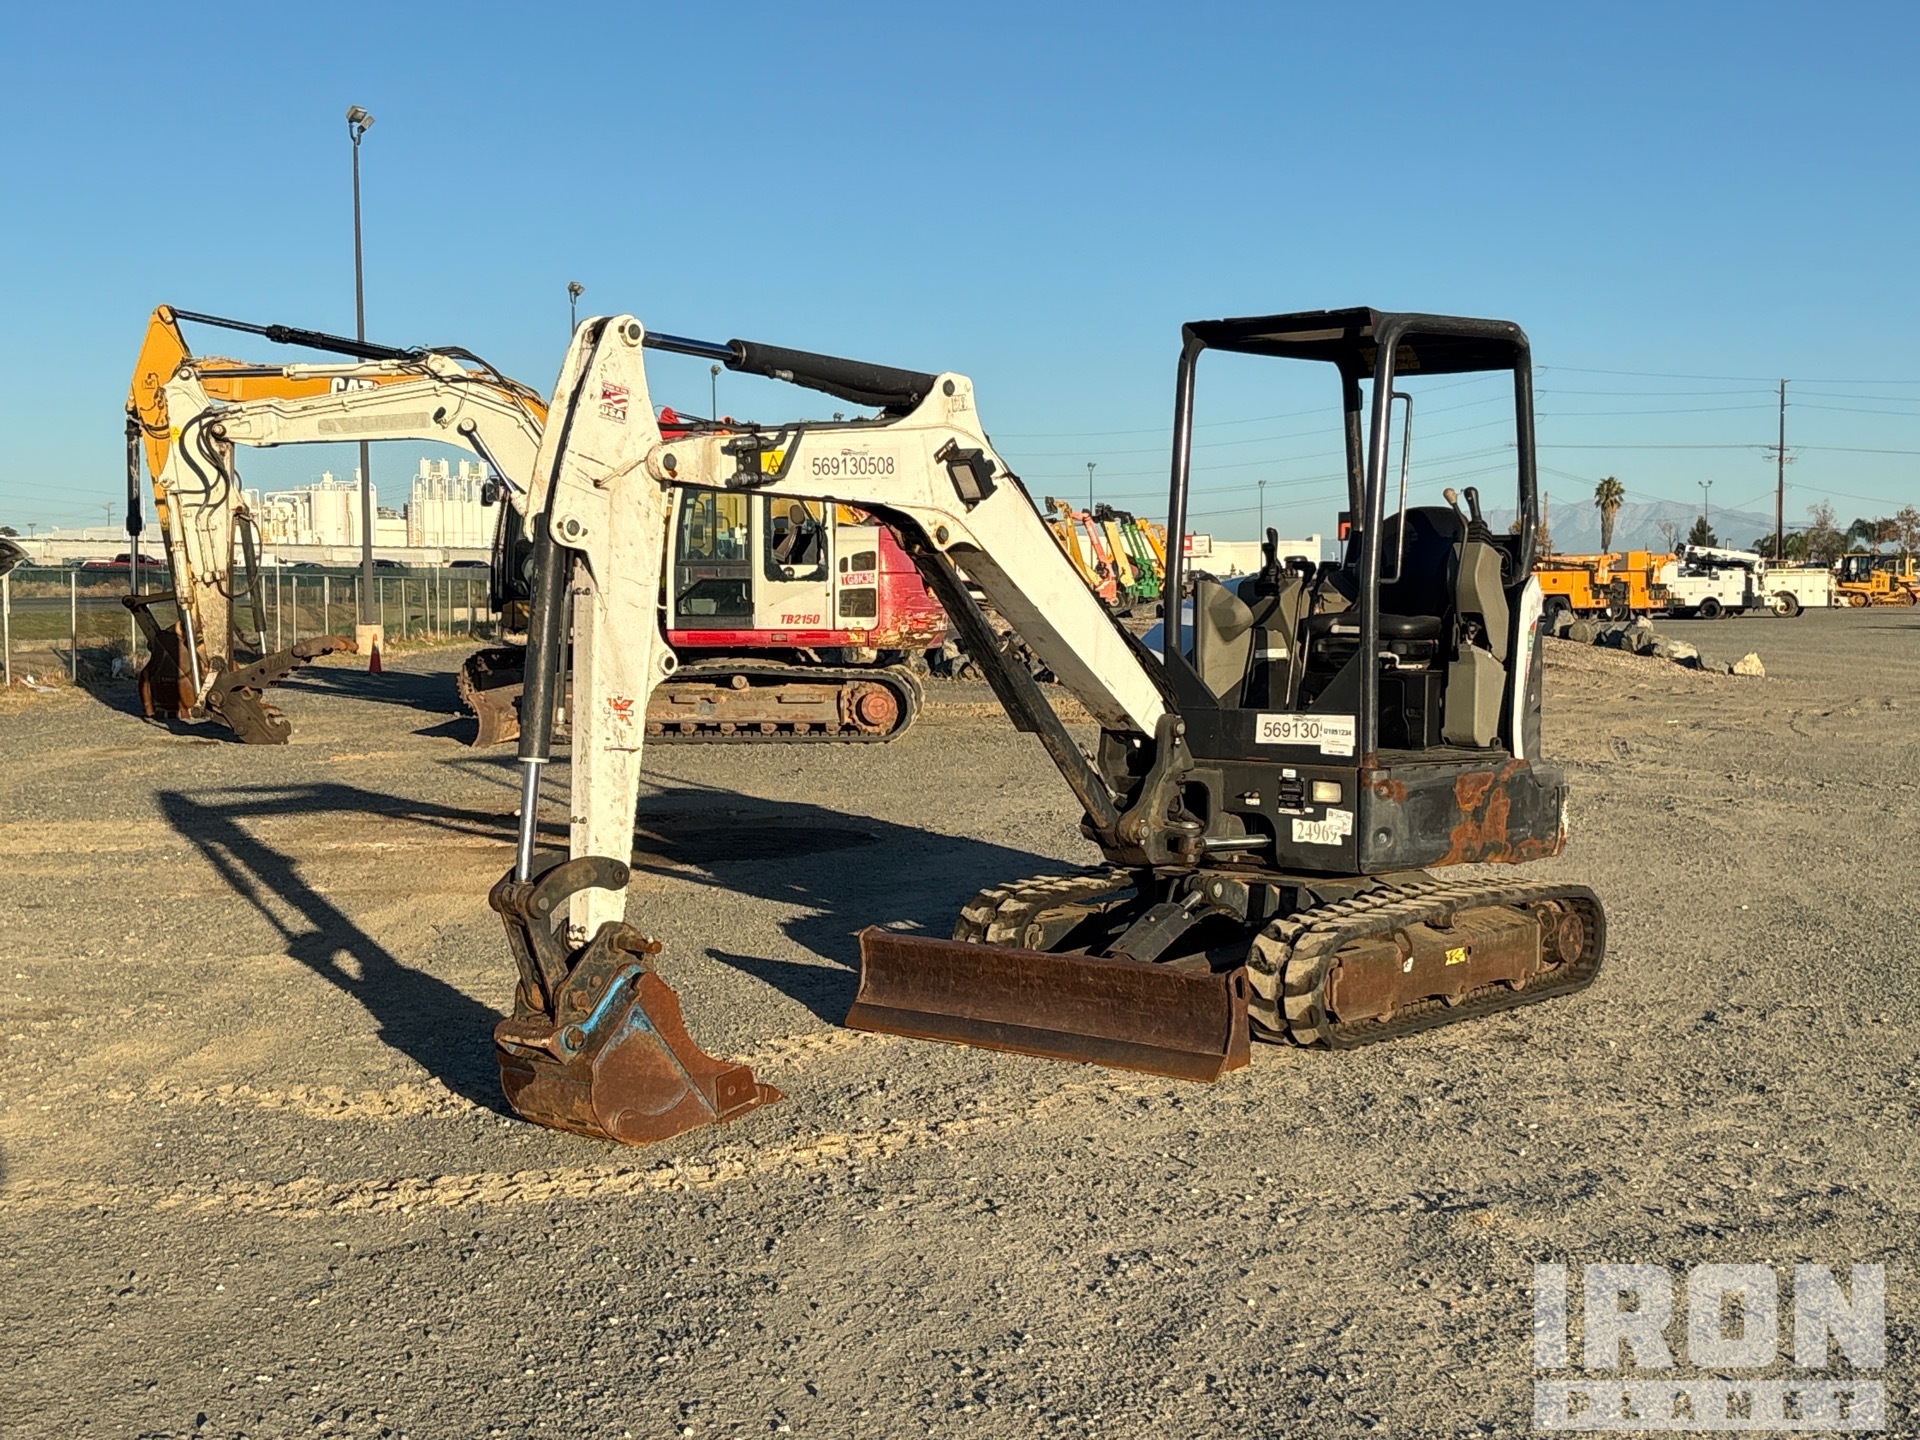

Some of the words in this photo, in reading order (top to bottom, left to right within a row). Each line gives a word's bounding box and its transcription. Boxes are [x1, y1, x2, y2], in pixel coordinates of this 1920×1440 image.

[601, 405, 625, 420] USA
[812, 457, 895, 475] 569130508
[781, 614, 820, 625] TB2150
[1263, 722, 1322, 738] 569130
